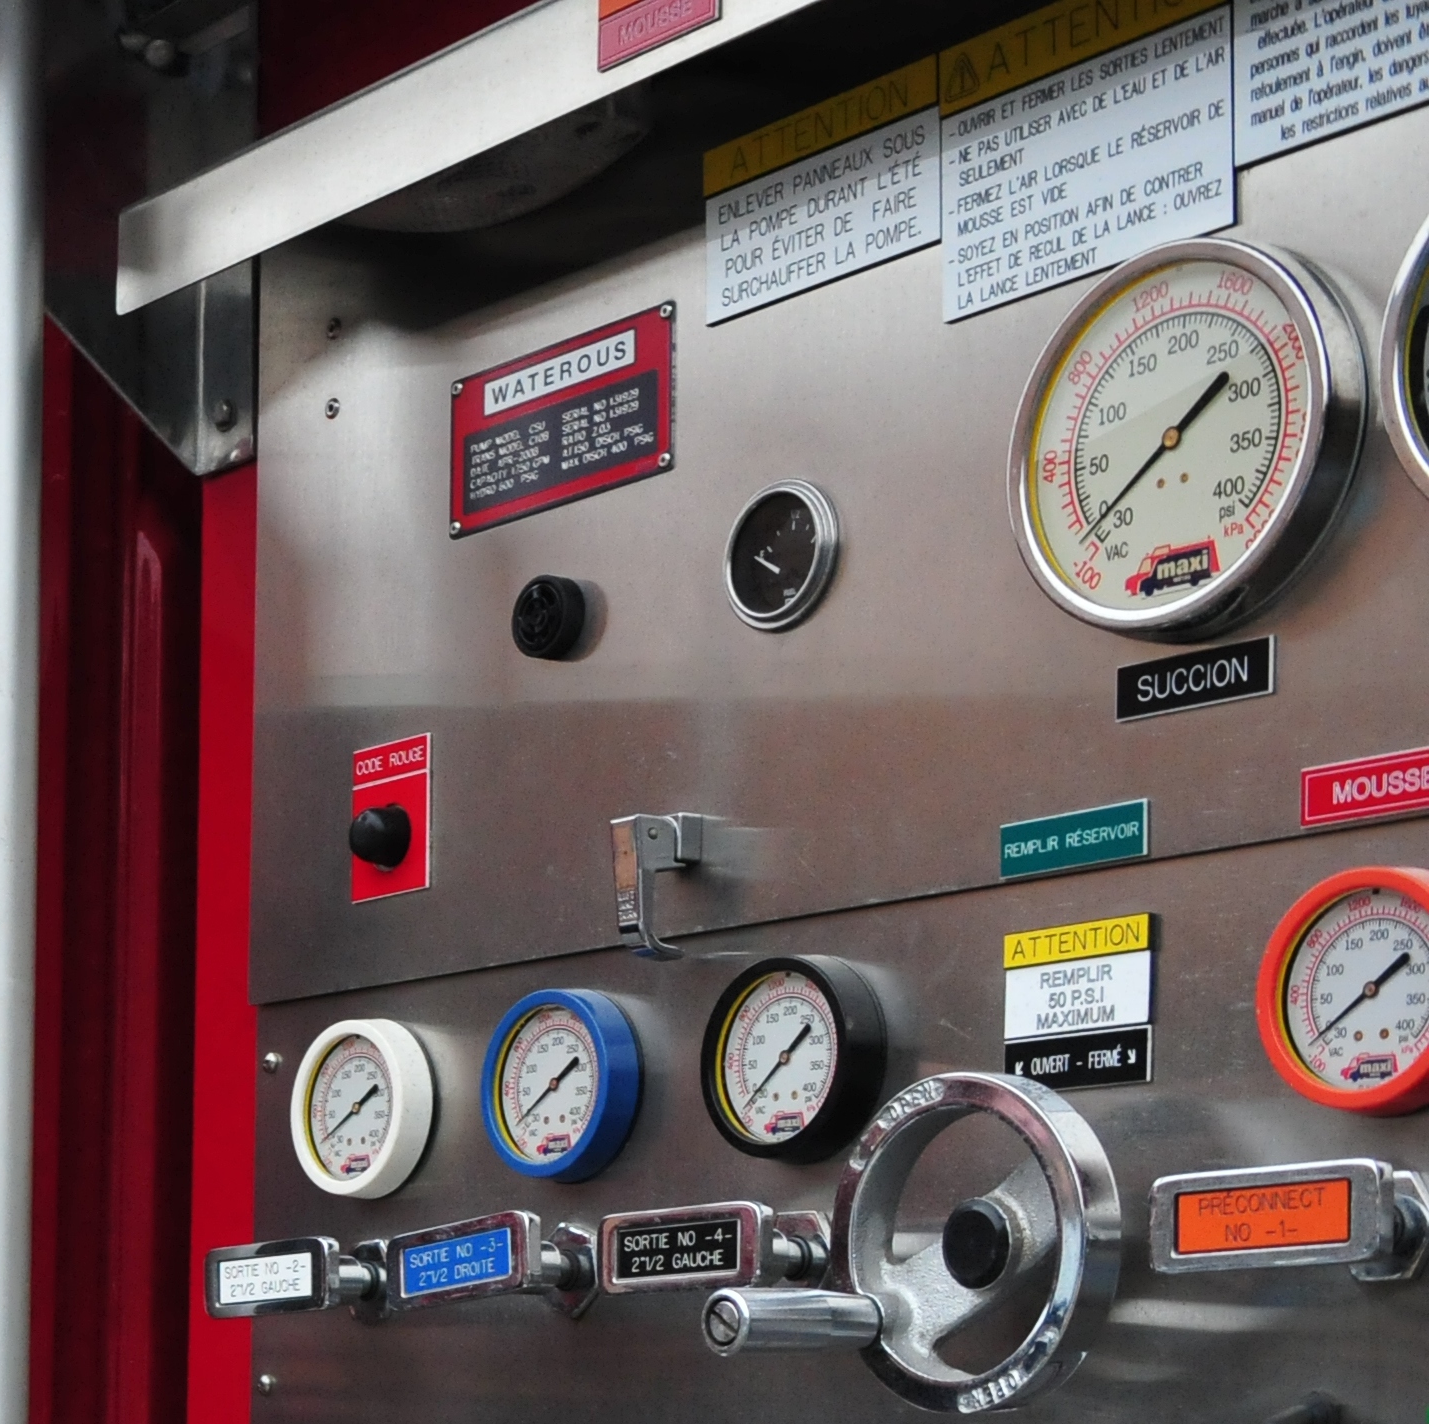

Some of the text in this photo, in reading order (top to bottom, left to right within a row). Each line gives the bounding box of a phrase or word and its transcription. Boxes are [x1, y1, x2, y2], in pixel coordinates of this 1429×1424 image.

[617, 0, 691, 45] MOUSSE
[987, 0, 1182, 82] ATTEN
[1001, 100, 1016, 120] ET
[1022, 80, 1065, 112] FERMER
[1071, 69, 1093, 92] LES
[1100, 48, 1148, 81] SORTIES
[1154, 15, 1225, 59] LENTEMENT
[978, 45, 1225, 157] PAS UTILISER AVEC DE L'EAU ET DE L'AIR
[729, 76, 909, 181] ATTENTION
[1008, 169, 1038, 195] L'AIR
[1044, 145, 1101, 182] LORSQUE
[1108, 137, 1124, 158] LE
[1131, 108, 1201, 149] RÉSERVOIR
[1208, 98, 1225, 121] DE
[718, 125, 926, 225] ENLEVER PANNEAUX SOUS
[959, 147, 1024, 187] SEULEMENT
[721, 151, 923, 252] LA POMPE DURANT L'ÉTÉ
[957, 181, 1068, 237] MOUSSE EST VIDE
[1002, 228, 1018, 248] EN
[1024, 205, 1079, 241] POSITION
[1085, 193, 1114, 219] AFIN
[1120, 184, 1137, 206] DE
[1143, 160, 1203, 197] CONTRER
[725, 187, 917, 278] POUR ÉVITER DE FAIRE
[957, 178, 1223, 288] L'EFFET DE RECUL DE LA LANCE OUVREZ
[722, 216, 922, 307] SURCHAUFFER LA POMPE.
[957, 246, 1098, 311] LA LANCE LENTEMENT
[1215, 271, 1254, 296] 1600
[1131, 280, 1169, 314] 1200
[1167, 330, 1200, 357] 200
[1206, 339, 1239, 366] 250
[491, 339, 628, 406] WATEROUS
[1068, 350, 1093, 385] 800
[1128, 354, 1158, 379] 150
[1228, 377, 1262, 403] 300
[1098, 402, 1127, 426] 100
[1229, 428, 1263, 454] 350
[1043, 449, 1058, 484] 400
[1088, 454, 1109, 476] 50
[1212, 475, 1245, 501] 400
[1112, 507, 1134, 529] 30
[1218, 501, 1236, 523] psi
[1105, 541, 1129, 561] VAC
[1155, 555, 1209, 578] maxi
[1137, 655, 1249, 702] SUCCION
[356, 745, 425, 776] CODE ROUGE
[1332, 765, 1429, 805] MOUSSE
[1004, 820, 1140, 859] REMPLIR RÉSERVOIR
[1012, 923, 1142, 962] ATTENTION
[1345, 938, 1363, 951] 150
[1369, 929, 1389, 942] 200
[1393, 938, 1413, 951] 250
[1039, 964, 1113, 990] REMPLIR
[1326, 964, 1344, 976] 100
[1048, 986, 1105, 1009] 50 P.S.I
[1320, 993, 1333, 1005] 50
[1036, 1005, 1116, 1031] MAXIMUM
[1030, 1046, 1122, 1075] OUVERT FERMÉ
[1198, 1184, 1325, 1217] PRÉCONNECT
[624, 1231, 670, 1252] SORTIE
[677, 1230, 696, 1247] NO
[1224, 1223, 1252, 1243] NO
[410, 1245, 473, 1269] SORTIE NO
[454, 1261, 495, 1280] DROITE
[672, 1250, 724, 1269] GAUCHE
[224, 1264, 258, 1280] SORTIE
[264, 1262, 281, 1276] NO
[261, 1278, 301, 1295] GAUCHE
